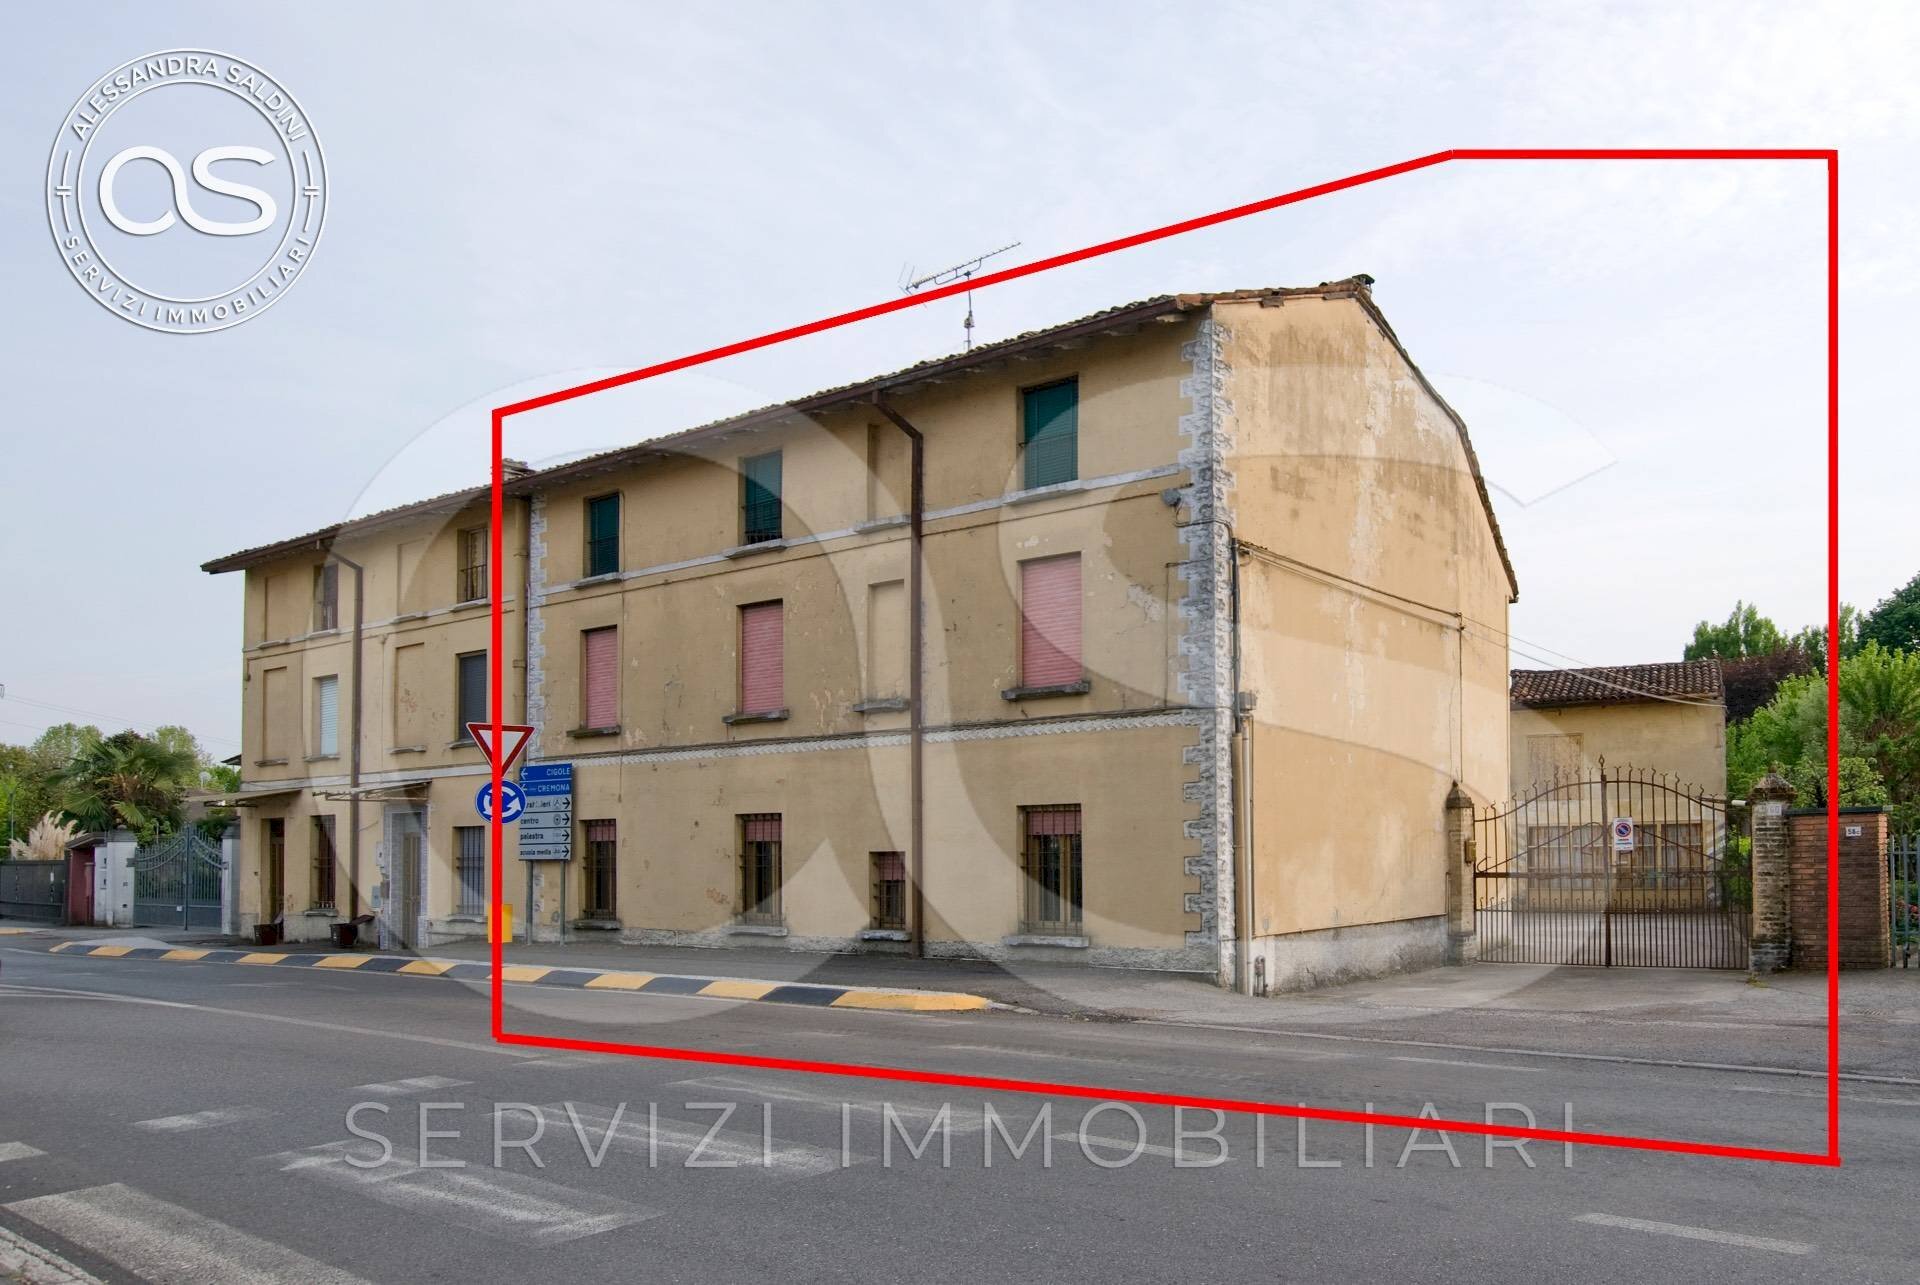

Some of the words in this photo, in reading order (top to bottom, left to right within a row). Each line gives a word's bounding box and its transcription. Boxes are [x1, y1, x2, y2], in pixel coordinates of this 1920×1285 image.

[546, 768, 571, 776] CIGOLE
[537, 784, 570, 792] CREMONA
[520, 817, 539, 825] centro
[520, 832, 544, 840] palestra
